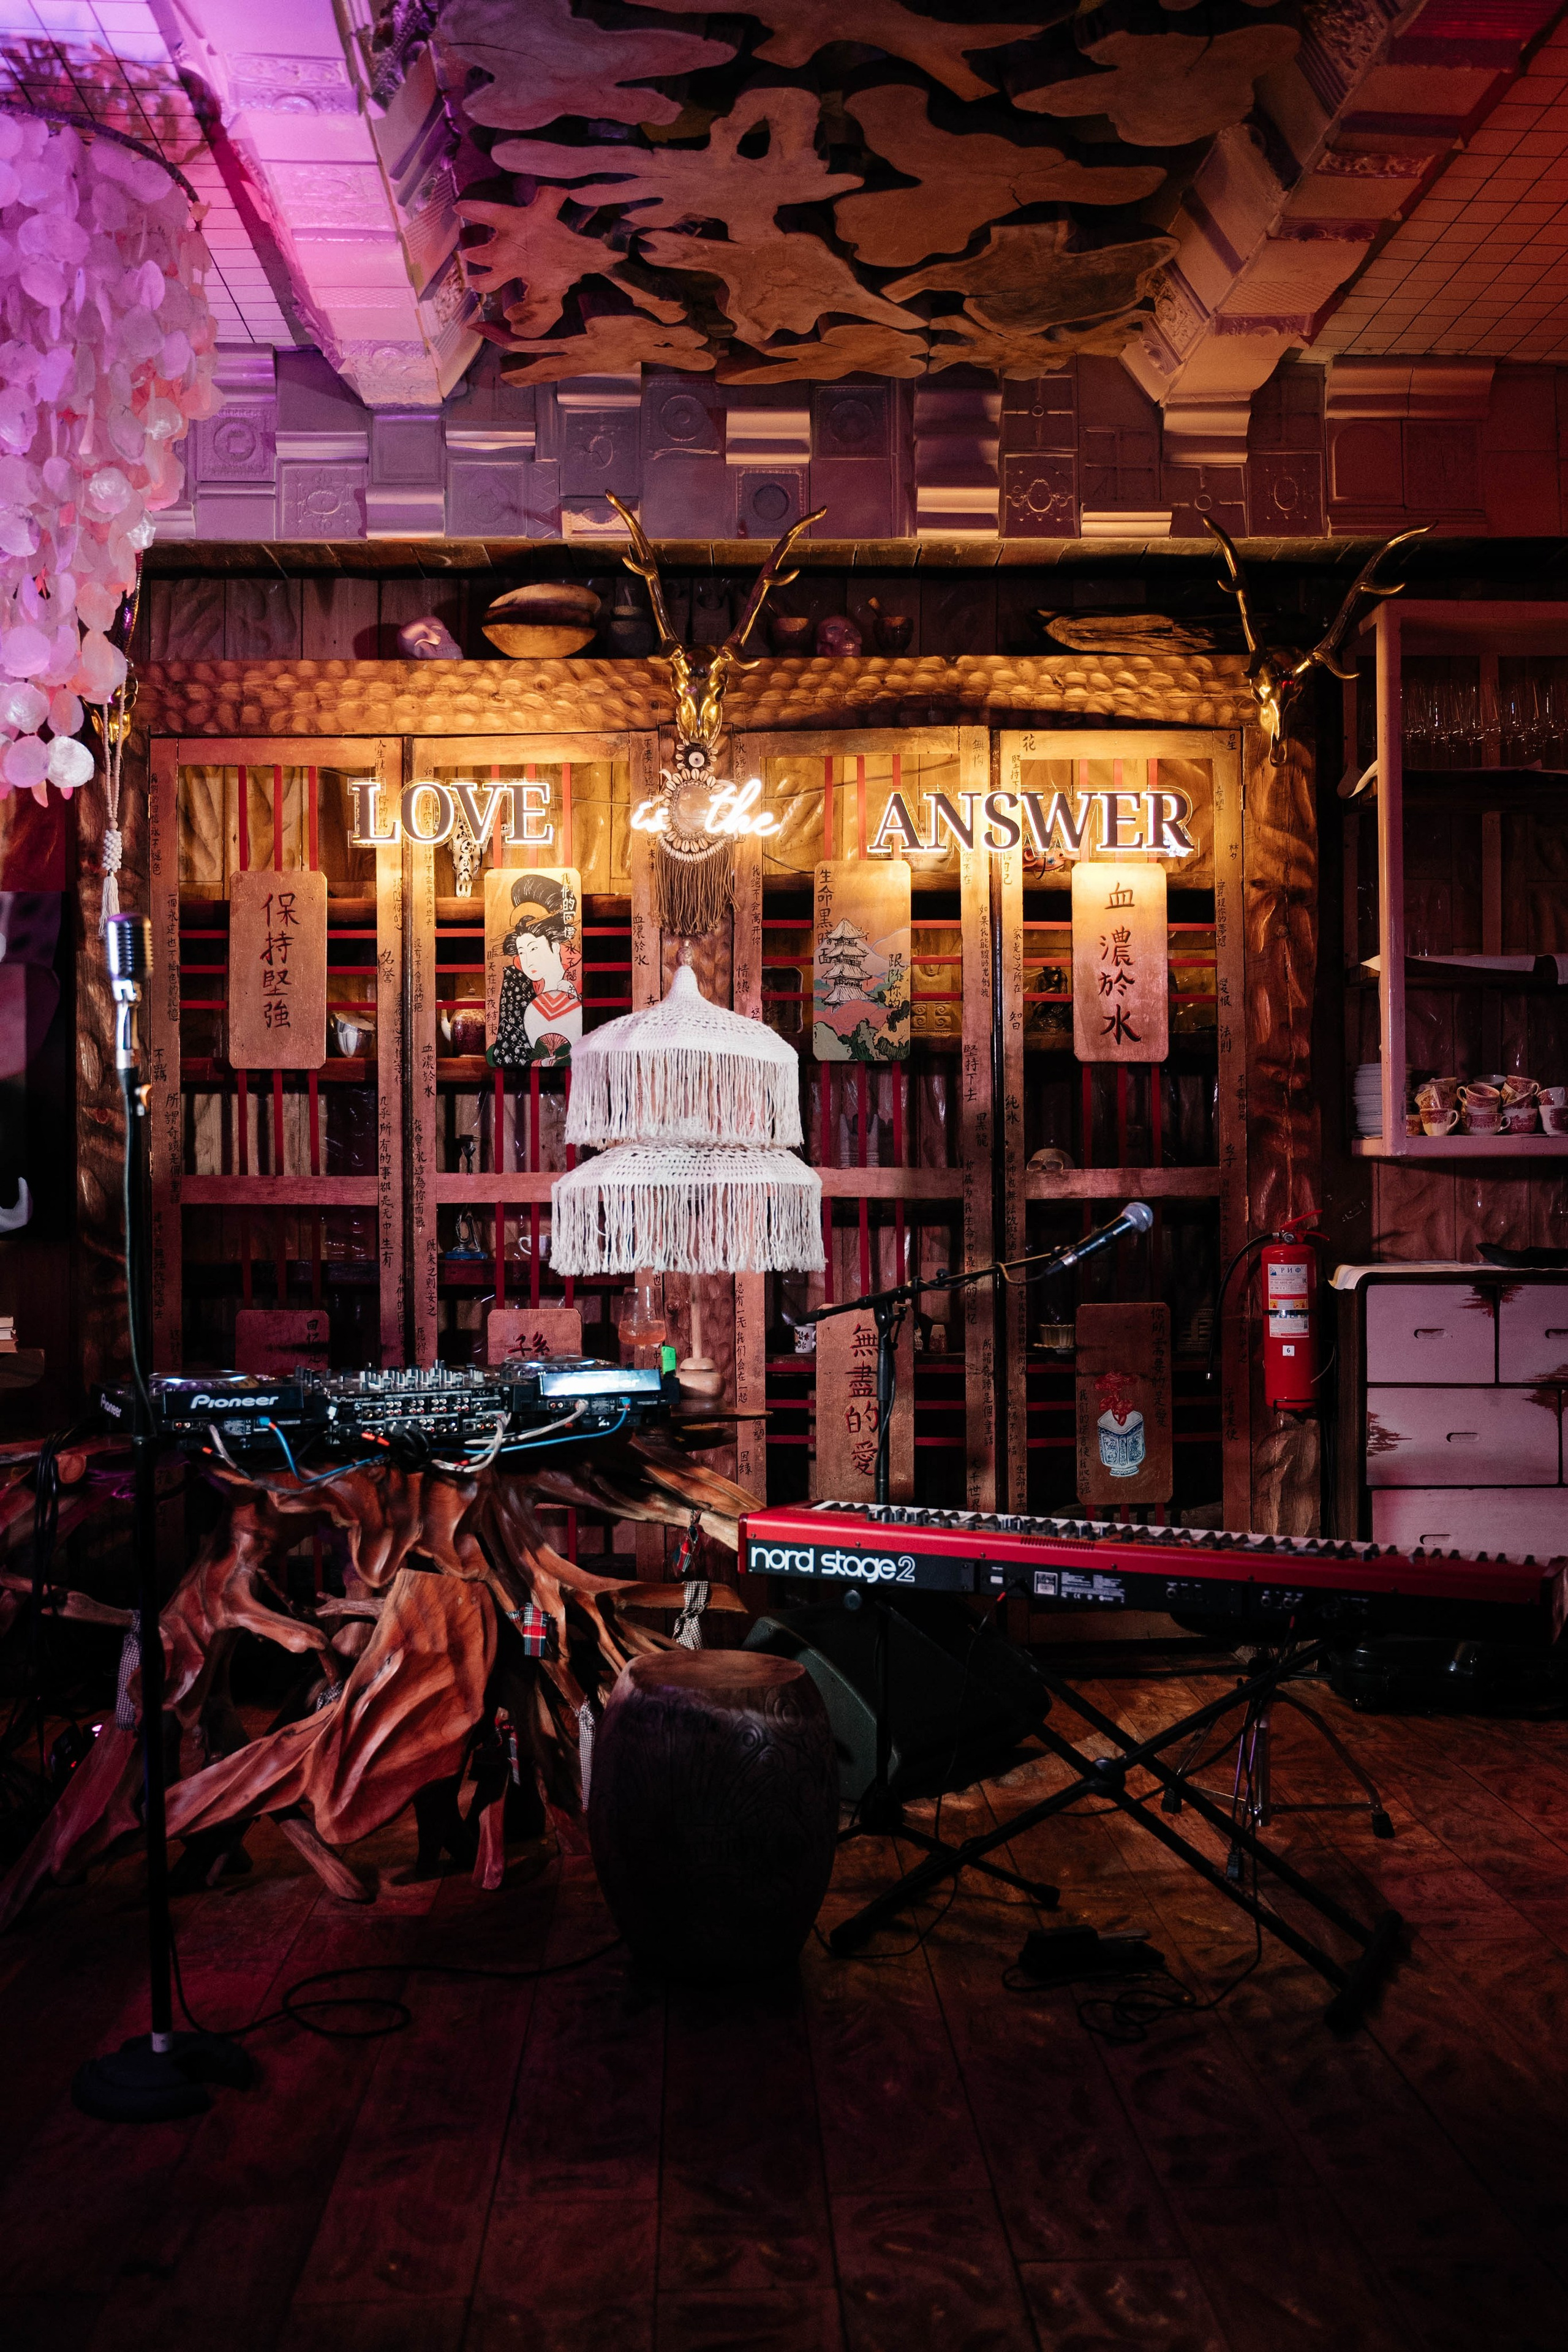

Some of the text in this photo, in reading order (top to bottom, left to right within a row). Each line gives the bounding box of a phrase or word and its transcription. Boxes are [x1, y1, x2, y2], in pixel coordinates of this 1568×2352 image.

[352, 782, 554, 845] LOVE
[631, 801, 668, 832] is
[704, 778, 781, 836] the
[867, 791, 1195, 853] ANSWER
[260, 893, 300, 1029] 保持堅強
[1098, 881, 1142, 1046] 血濃於水
[100, 1392, 122, 1418] Pioneer
[190, 1395, 279, 1409] Pioneer
[845, 1323, 879, 1476] 無盡的愛
[751, 1547, 814, 1573] nord
